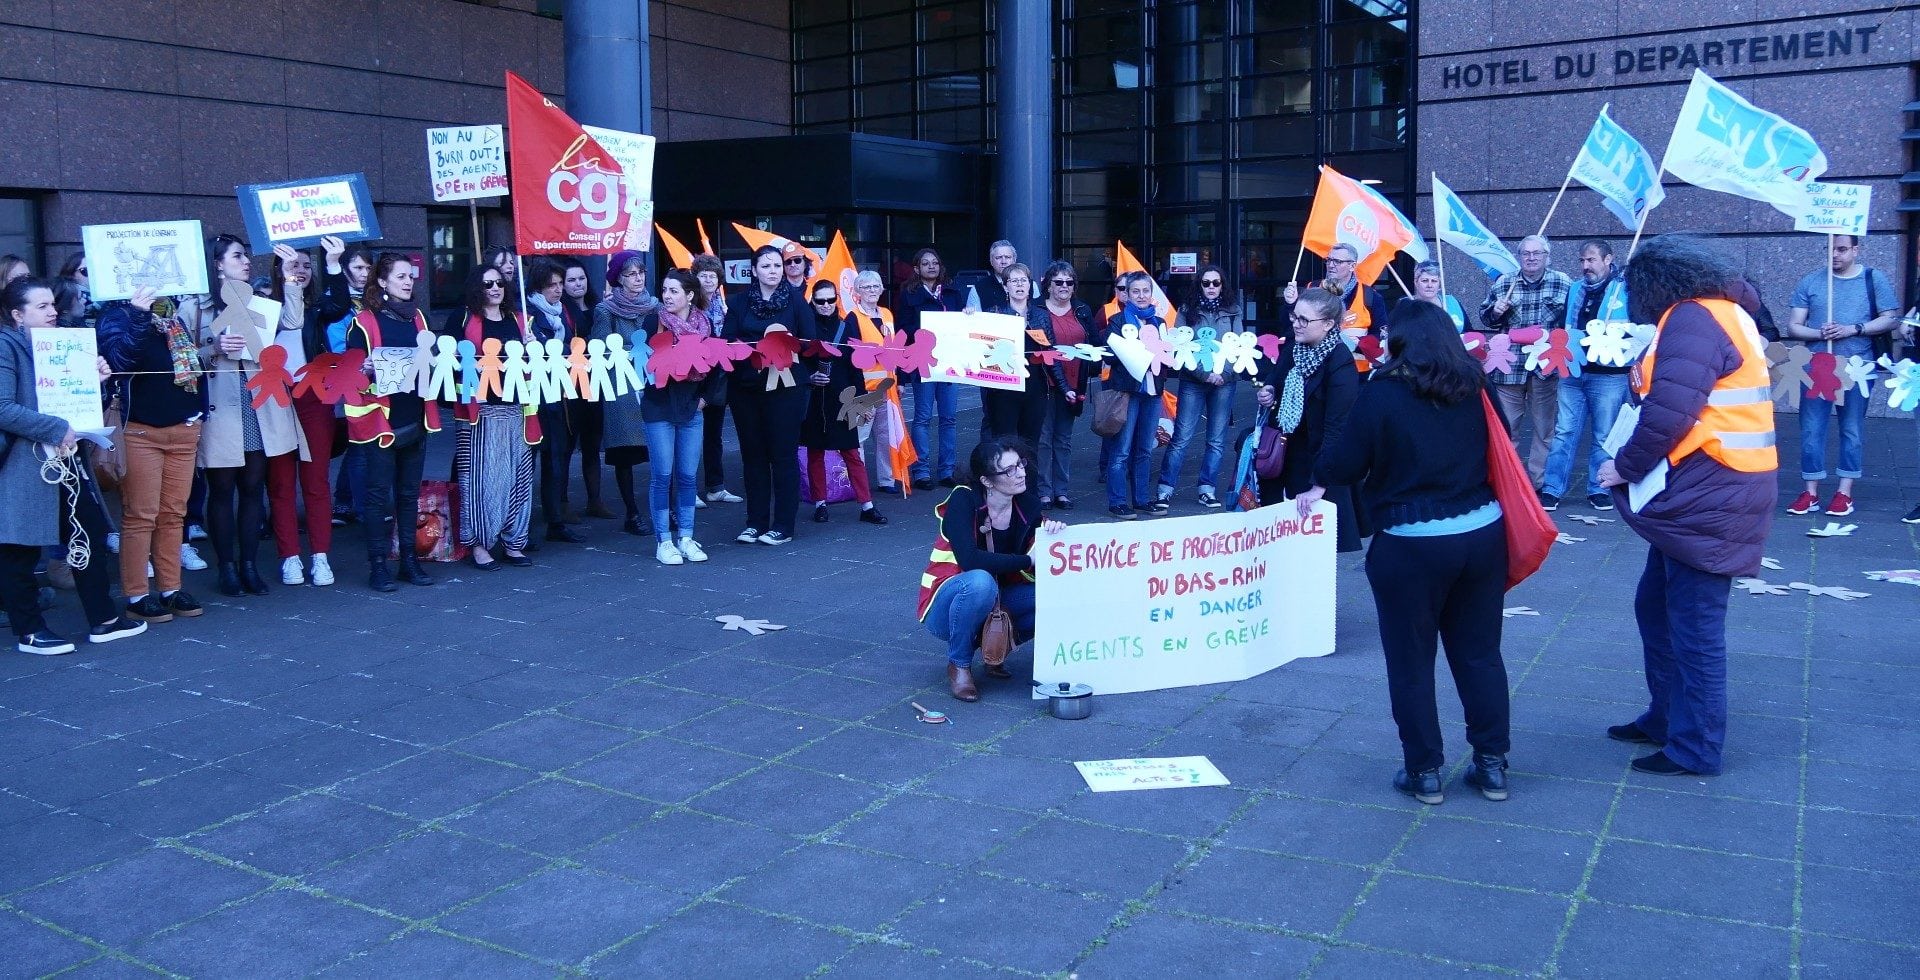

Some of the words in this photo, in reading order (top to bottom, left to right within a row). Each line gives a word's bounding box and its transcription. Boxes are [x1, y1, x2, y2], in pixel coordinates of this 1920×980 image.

[1443, 60, 1538, 89] HOTEL
[1555, 53, 1596, 79] DU
[1614, 27, 1879, 75] DEPARTEMENT
[432, 131, 448, 145] NON
[457, 130, 472, 142] AU
[435, 150, 463, 167] BURN
[437, 169, 453, 179] DES
[462, 163, 498, 175] AGENTS
[290, 187, 320, 198] NON
[436, 179, 461, 197] SPE
[463, 182, 475, 191] EN
[1806, 184, 1826, 193] STOP
[1846, 187, 1858, 196] LA
[271, 201, 290, 213] AU
[303, 209, 317, 217] EN
[107, 229, 140, 238] PROJECTION
[271, 220, 305, 234] MODE
[534, 240, 600, 249] Départemental
[603, 231, 626, 249] 67
[569, 232, 600, 241] Conseil
[1150, 540, 1174, 564] DE
[1148, 577, 1169, 599] DU
[1150, 607, 1174, 622] EN
[1200, 589, 1262, 617] DANGER
[1053, 636, 1144, 666] AGENTS
[1164, 637, 1188, 651] EN
[1206, 618, 1269, 649] GRÈVE
[1132, 775, 1184, 784] ACTES
